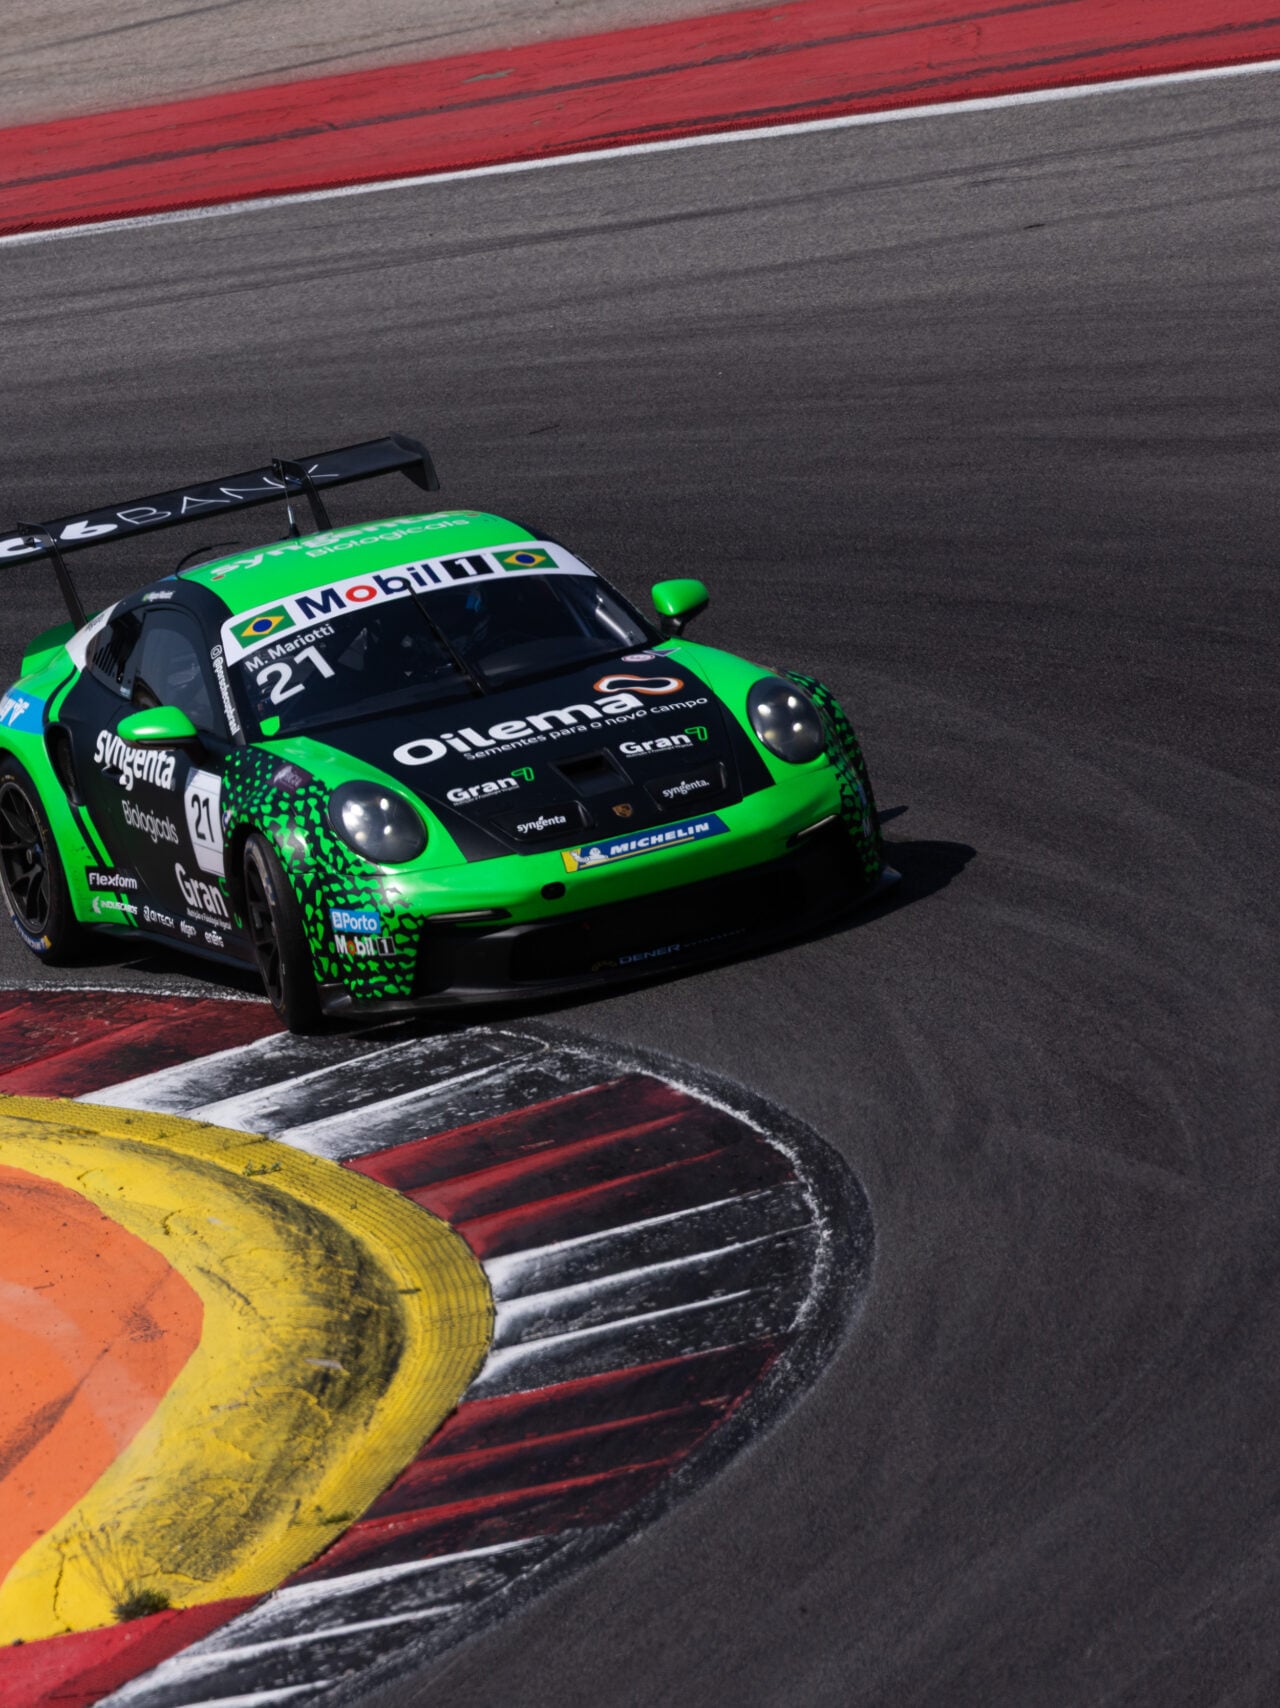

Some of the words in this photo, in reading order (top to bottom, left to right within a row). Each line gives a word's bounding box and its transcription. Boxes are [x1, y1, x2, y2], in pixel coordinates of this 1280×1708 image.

[306, 518, 470, 558] Biologicals
[294, 563, 441, 621] Mobil
[245, 656, 269, 673] M.
[267, 624, 336, 661] Mariotti
[256, 645, 336, 706] 21
[393, 692, 644, 766] Oilema
[463, 734, 547, 761] Sementes
[549, 723, 588, 741] para
[591, 721, 603, 729] o
[605, 708, 648, 727] novo
[651, 697, 709, 717] campo
[619, 732, 692, 756] Gran
[94, 729, 176, 791] syngenta
[446, 775, 518, 803] Gran
[661, 779, 708, 799] syngenta
[122, 800, 179, 844] Biologicals
[191, 793, 216, 843] 21
[516, 814, 567, 834] syngenta
[609, 822, 710, 857] MICHELIN
[88, 872, 138, 889] Flexform
[175, 862, 229, 918] Gran
[342, 912, 378, 931] Porto
[334, 934, 375, 956] Mobil
